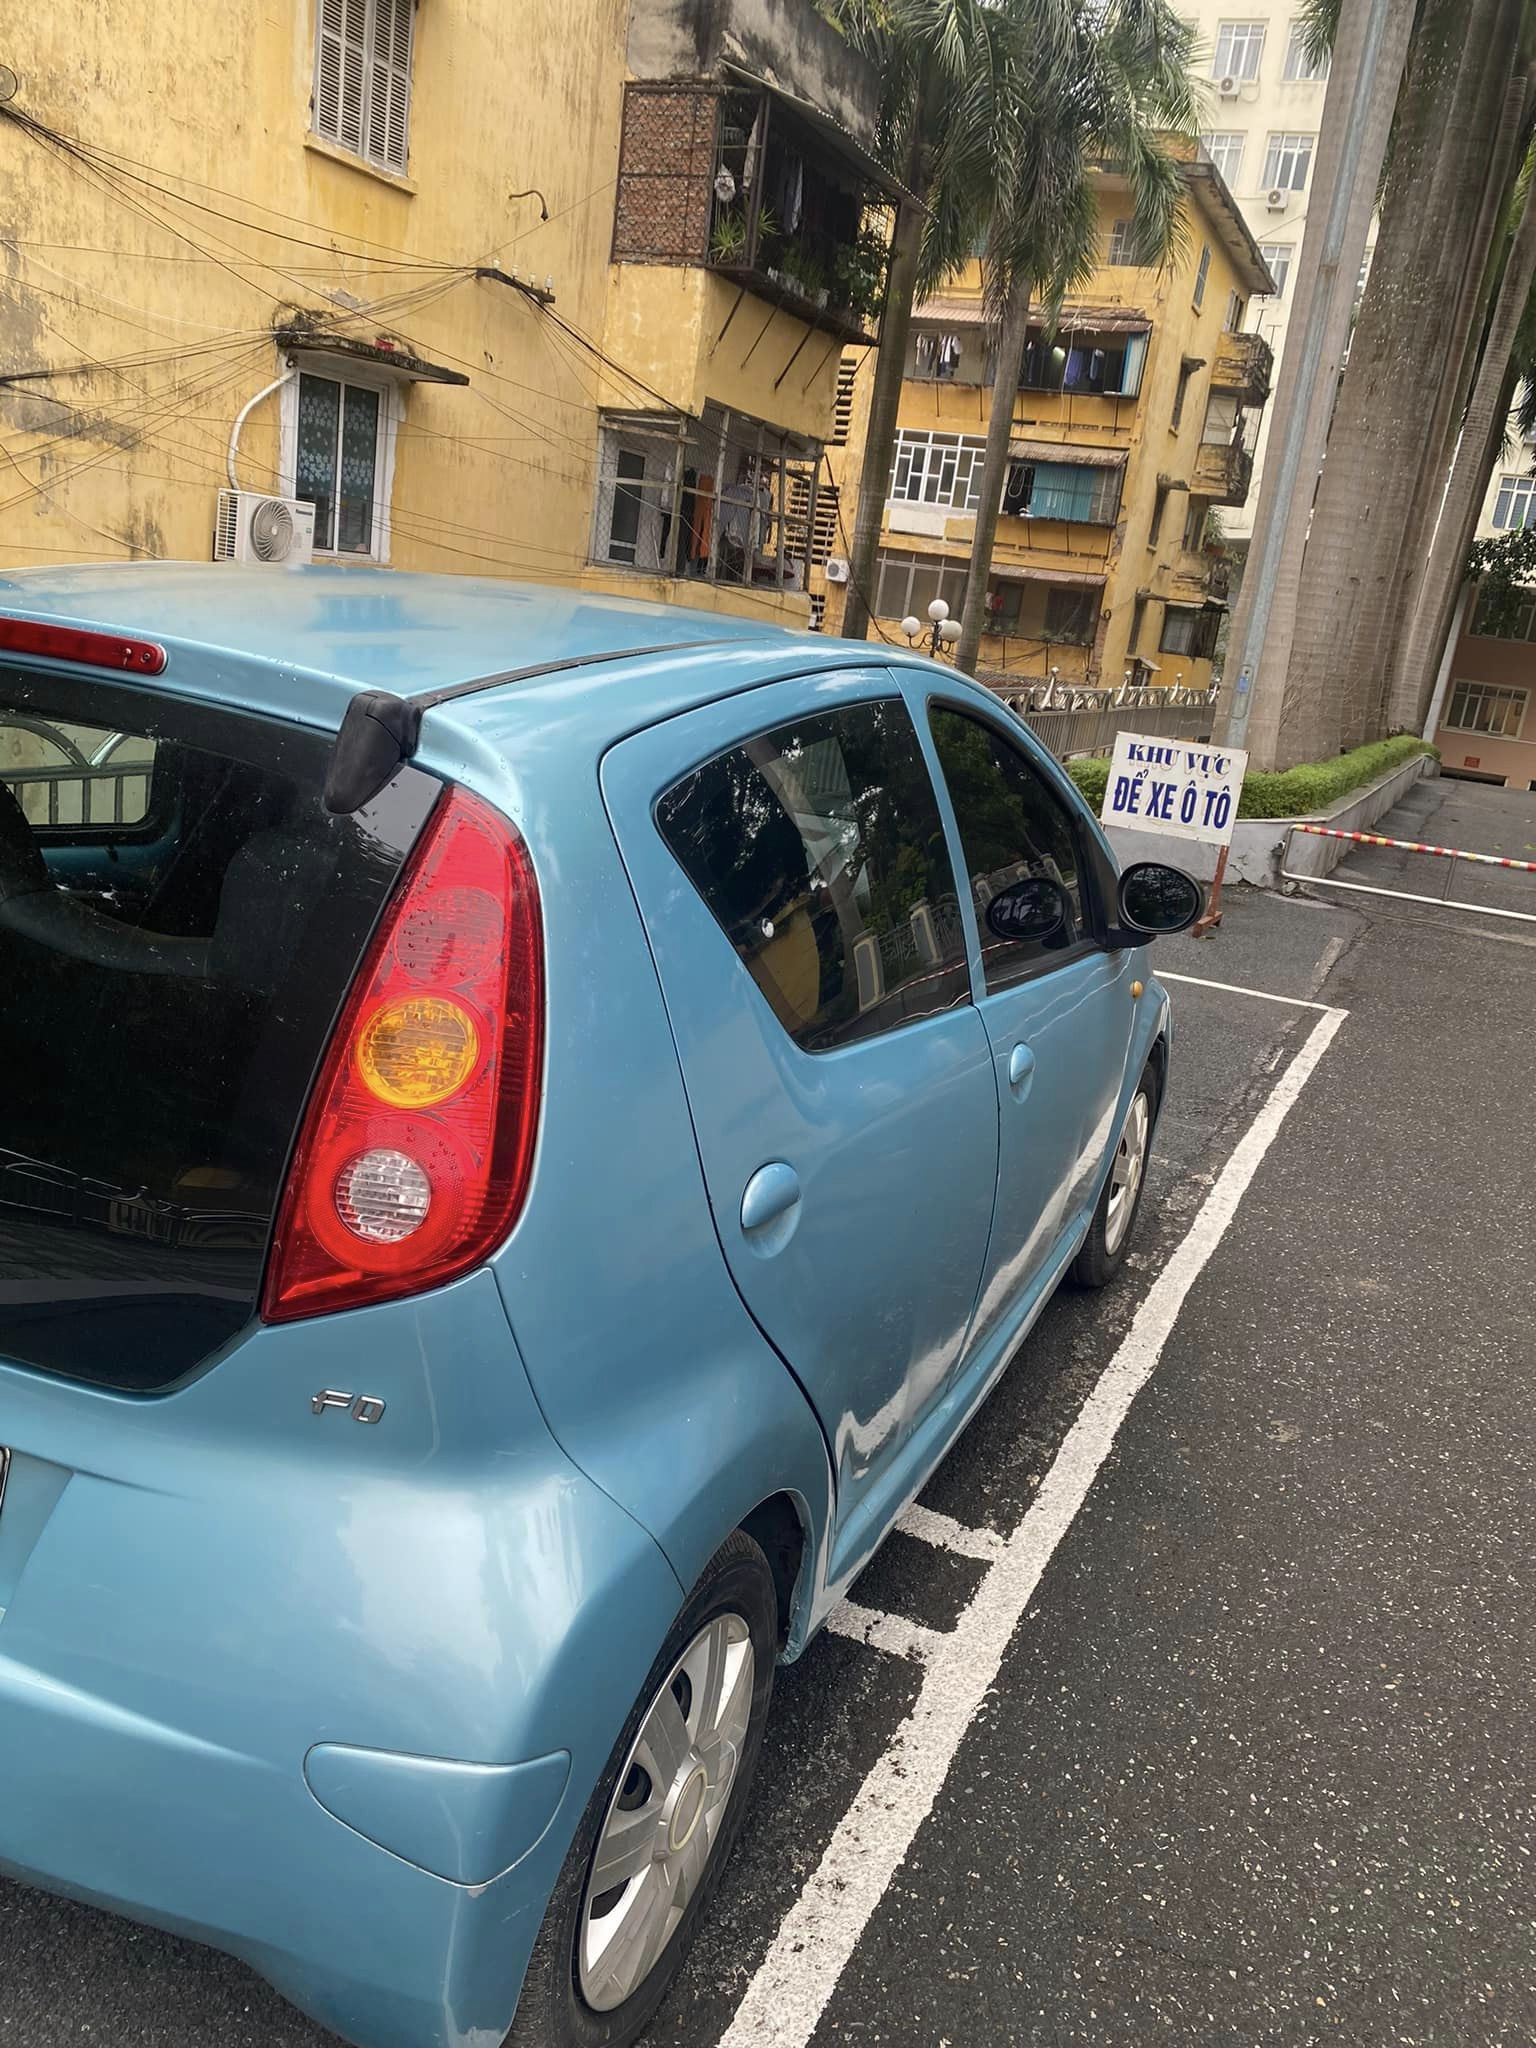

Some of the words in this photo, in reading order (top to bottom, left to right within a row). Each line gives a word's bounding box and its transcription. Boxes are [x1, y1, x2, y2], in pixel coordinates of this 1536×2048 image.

[1128, 743, 1181, 766] KHU
[1185, 752, 1231, 779] VỰC
[1112, 769, 1149, 814] ĐỂ
[1145, 781, 1178, 820] XE
[1180, 780, 1198, 824] Ô
[1203, 785, 1231, 829] TÔ
